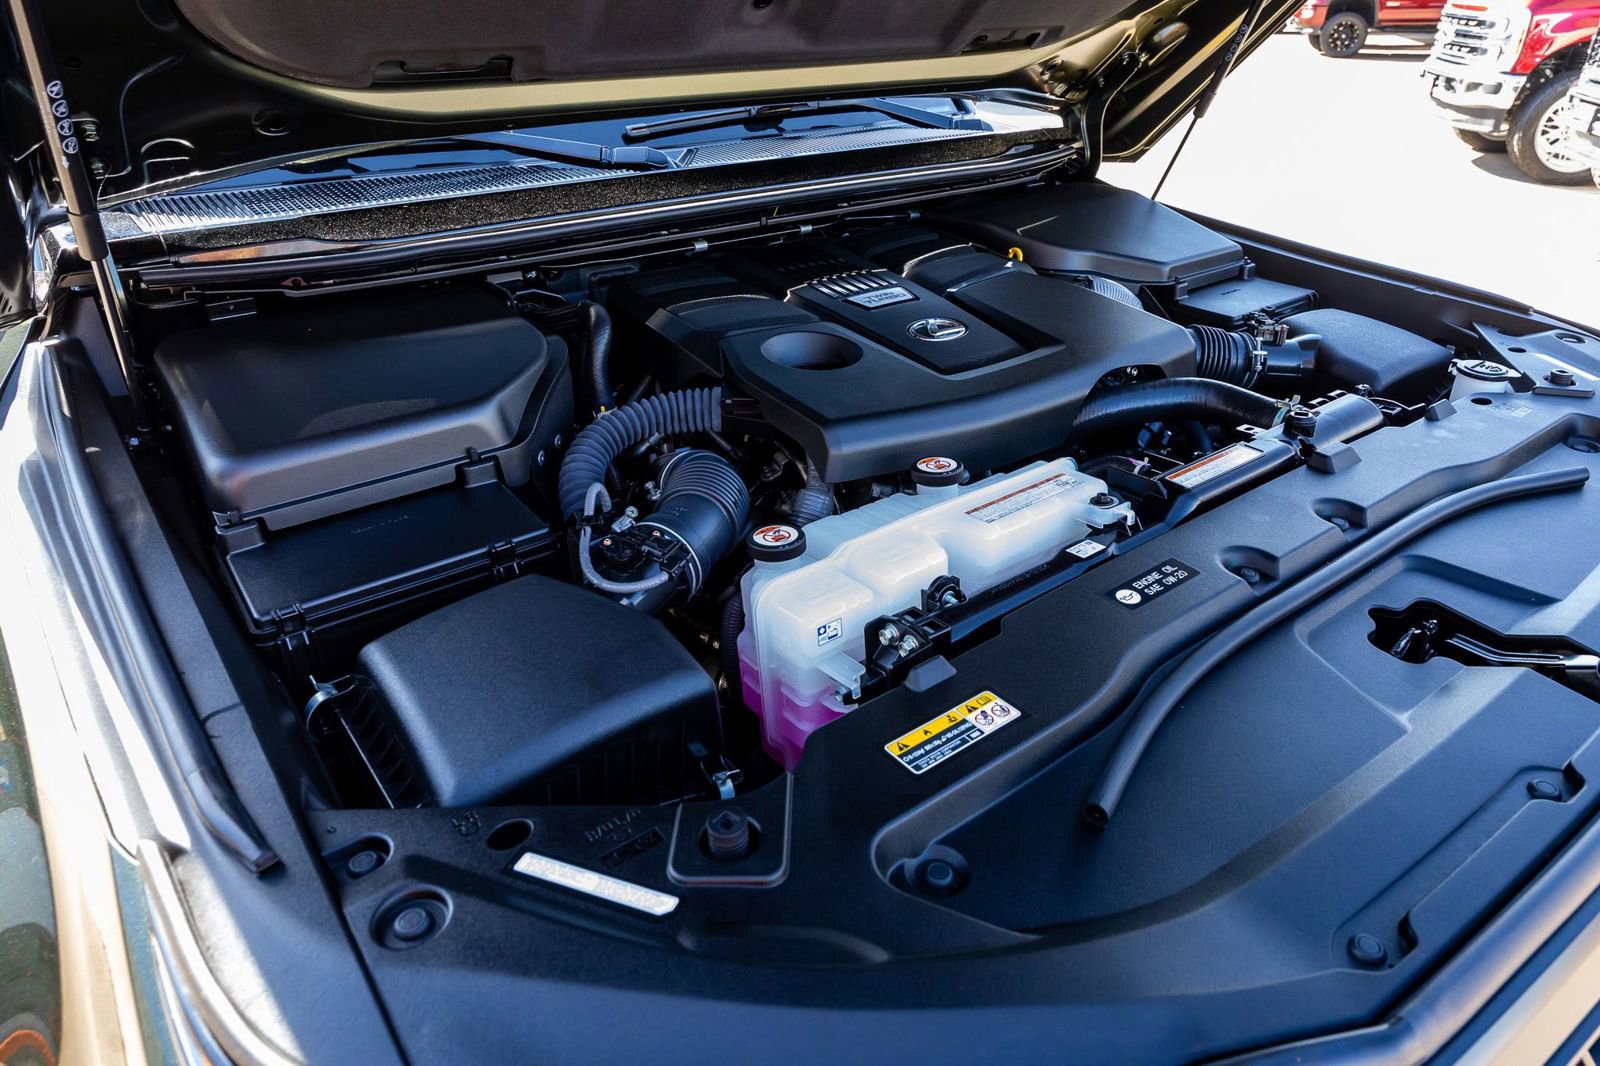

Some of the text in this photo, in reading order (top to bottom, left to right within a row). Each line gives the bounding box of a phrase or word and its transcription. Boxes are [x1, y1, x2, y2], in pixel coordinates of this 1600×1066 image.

[1132, 565, 1178, 589] ENGINE OIL
[1144, 570, 1188, 595] SAE 0W-20
